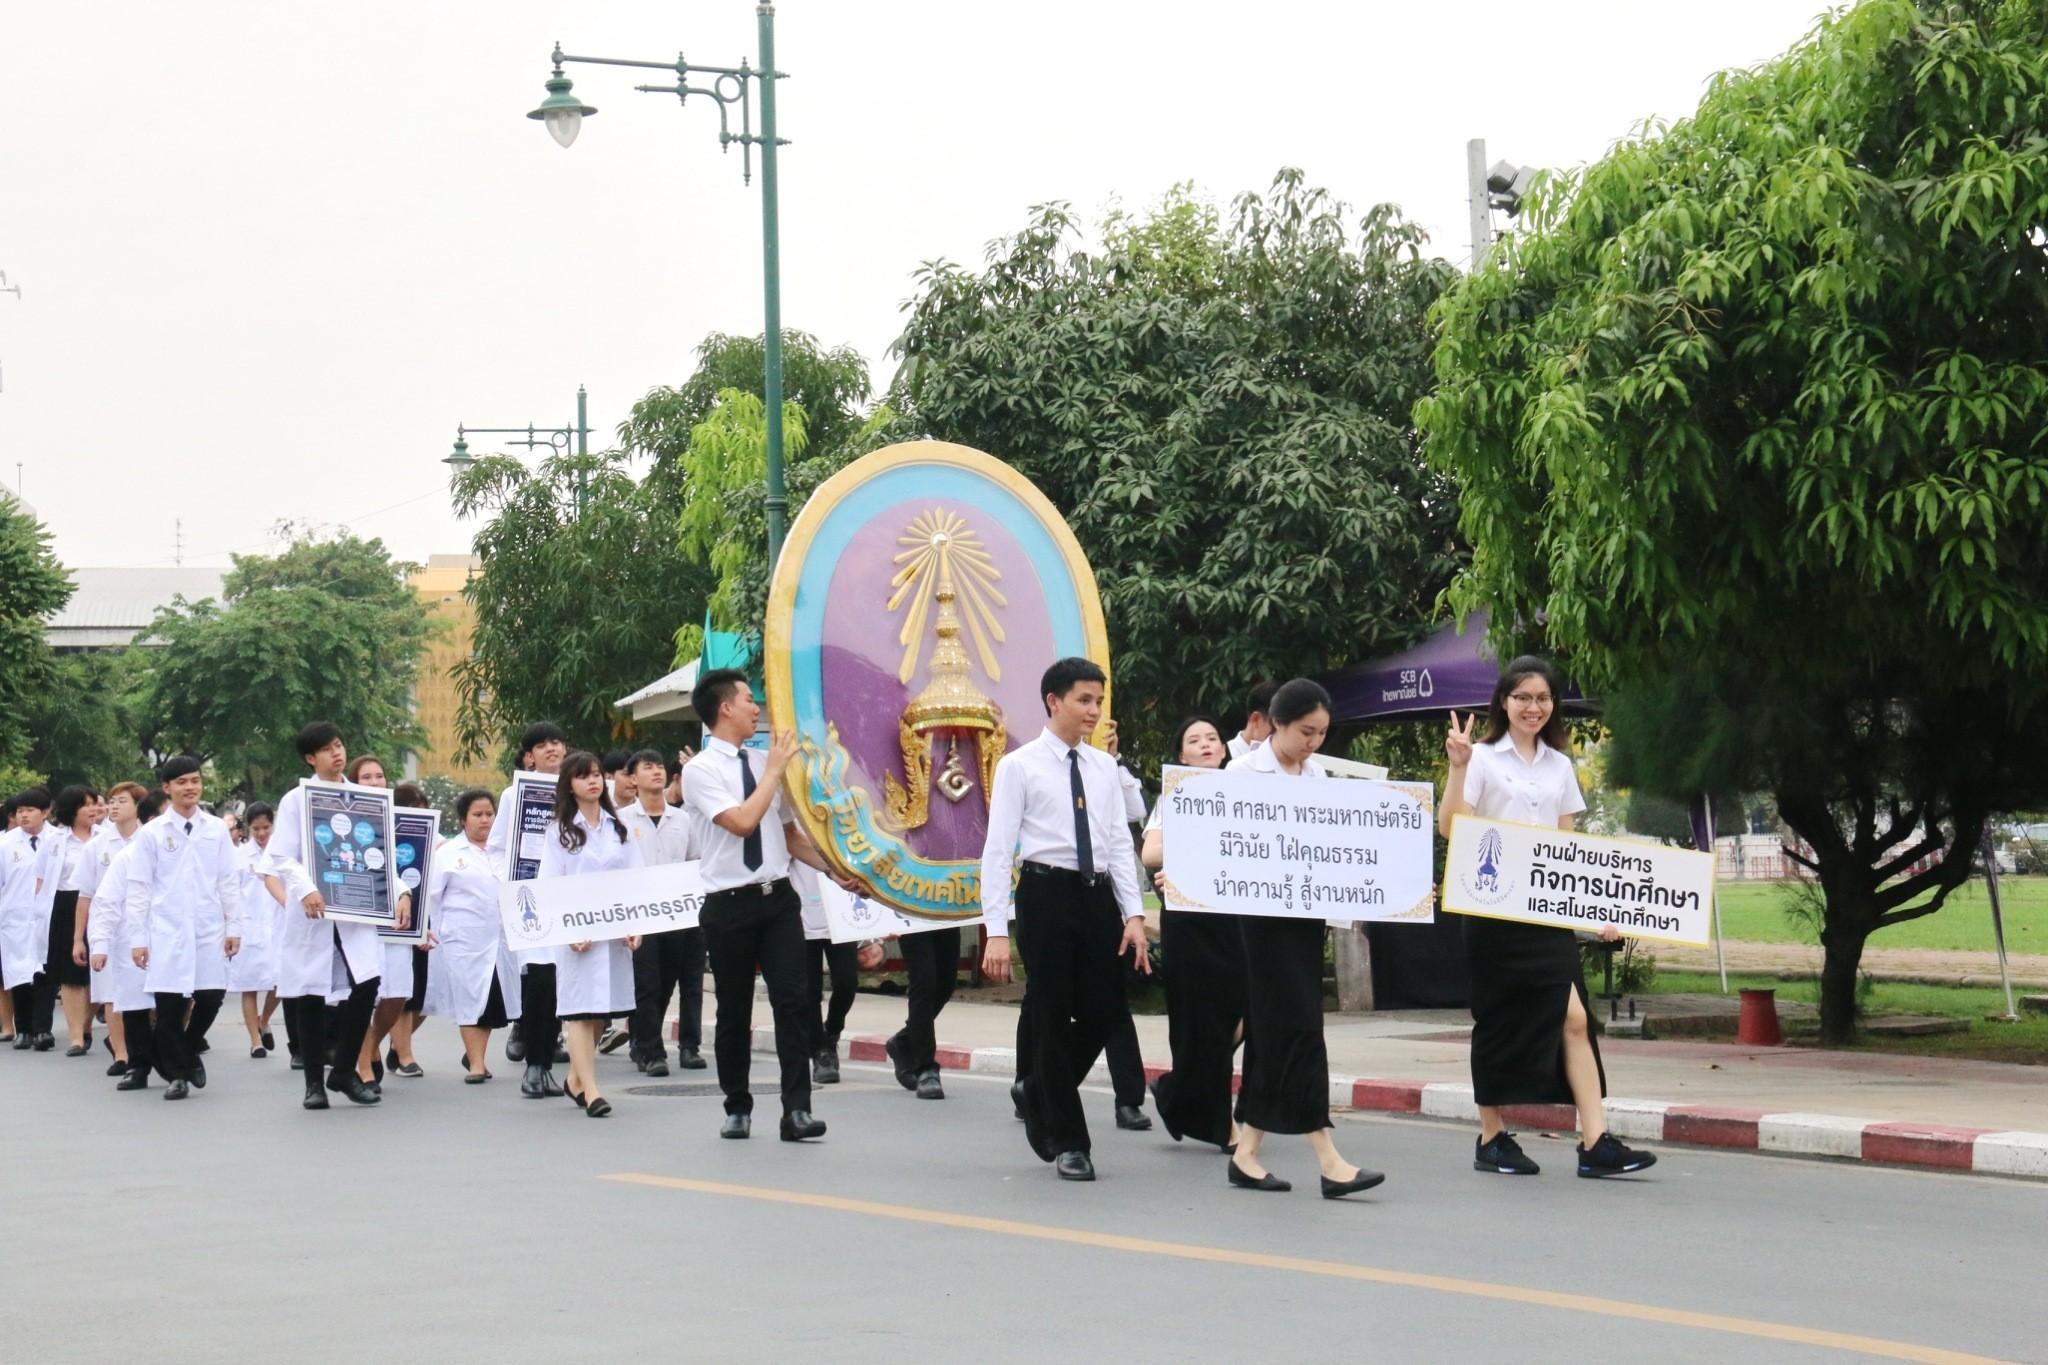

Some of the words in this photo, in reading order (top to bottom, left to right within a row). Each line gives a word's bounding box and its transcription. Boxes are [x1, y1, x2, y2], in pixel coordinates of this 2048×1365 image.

[1400, 670, 1416, 683] SCB
[1172, 787, 1226, 817] รักชาติ
[1233, 800, 1287, 822] ศาสนา
[1294, 801, 1423, 830] พระมหากษัตริย์
[1220, 830, 1270, 859] มีวินัย
[1276, 833, 1378, 871] ใฝ่คุณธรรม
[1533, 841, 1653, 874] งานฝ่ายบริหาร
[1213, 870, 1293, 910] นำความรู้
[1300, 875, 1385, 911] สู้งานหนัก
[1530, 862, 1700, 911] กิจการนักศึกษา
[1527, 896, 1680, 932] และสโมสรนักศึกษา
